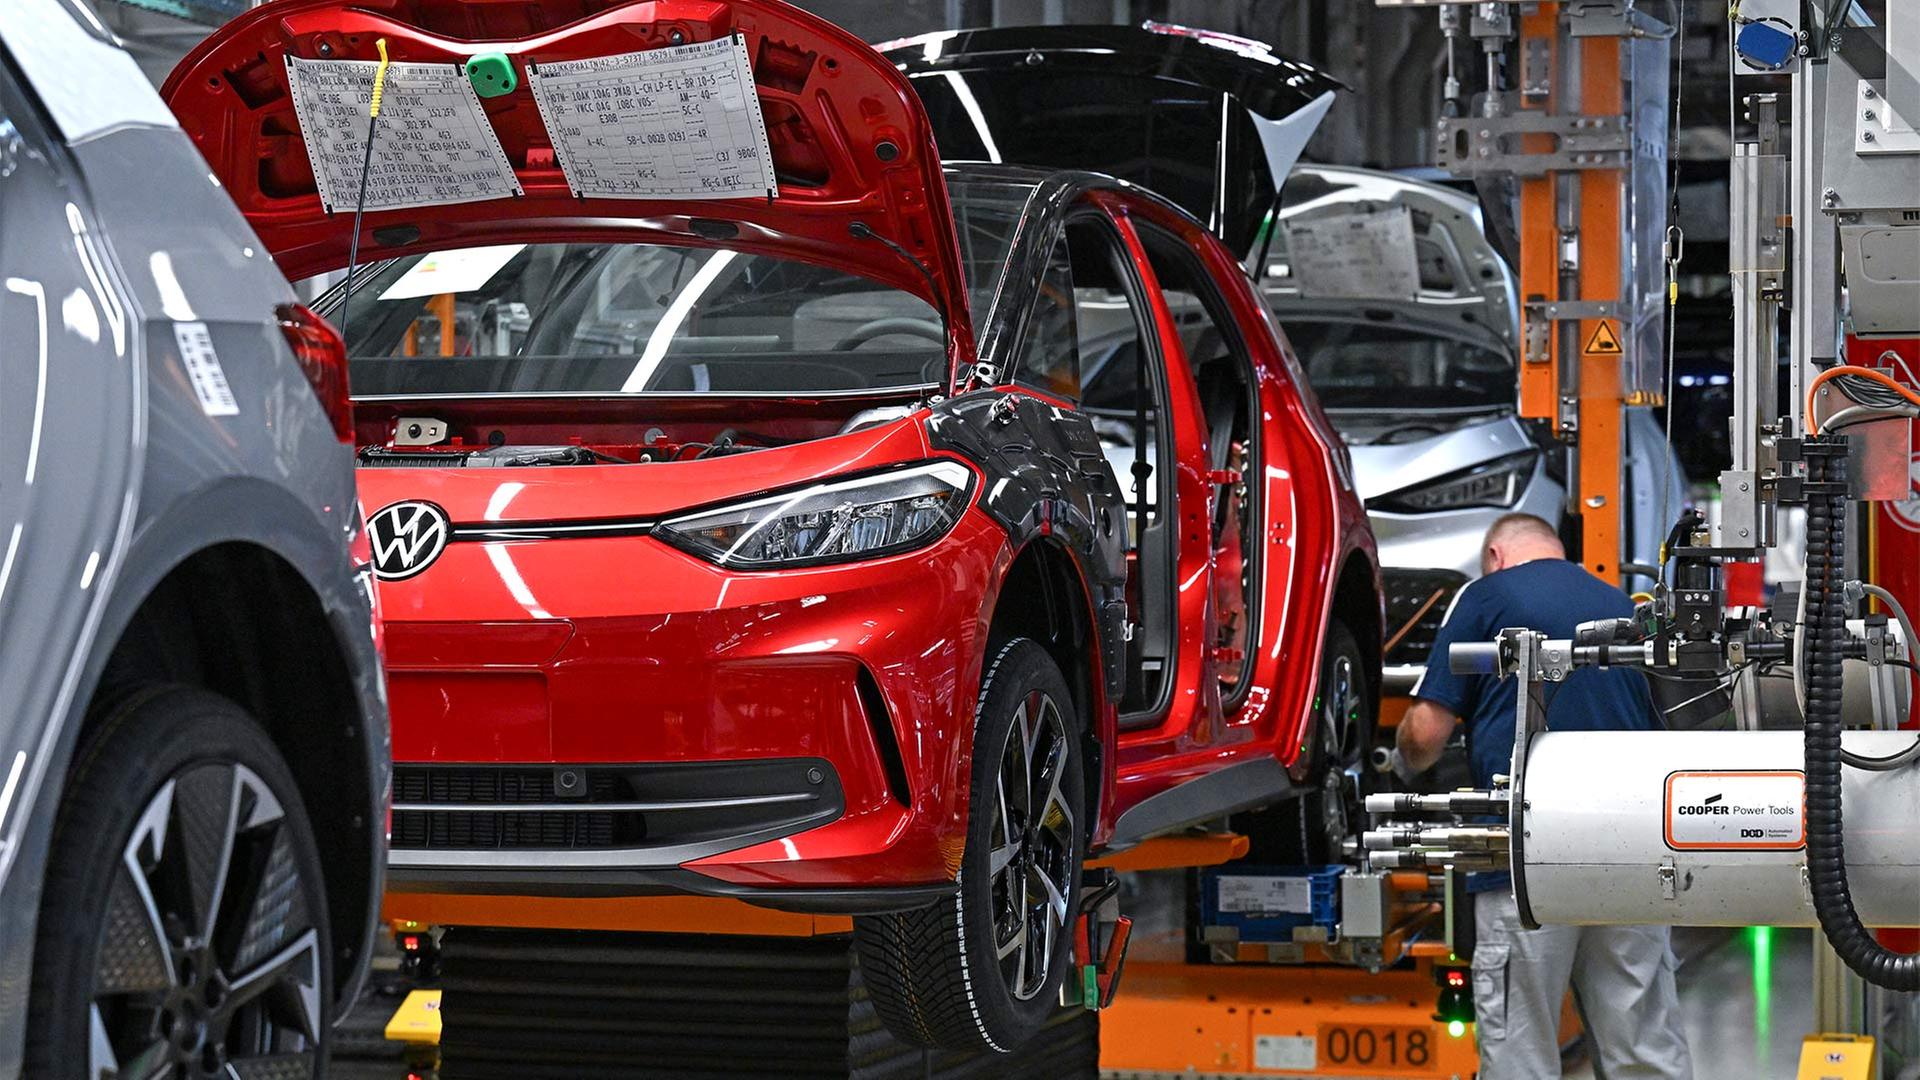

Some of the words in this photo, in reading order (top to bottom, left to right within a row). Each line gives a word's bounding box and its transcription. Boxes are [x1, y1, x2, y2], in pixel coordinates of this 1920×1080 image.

[650, 50, 668, 60] 5679
[1678, 806, 1730, 815] COOPER
[1733, 806, 1765, 815] Power
[1768, 806, 1794, 815] Tools
[1327, 1028, 1429, 1066] 0018
